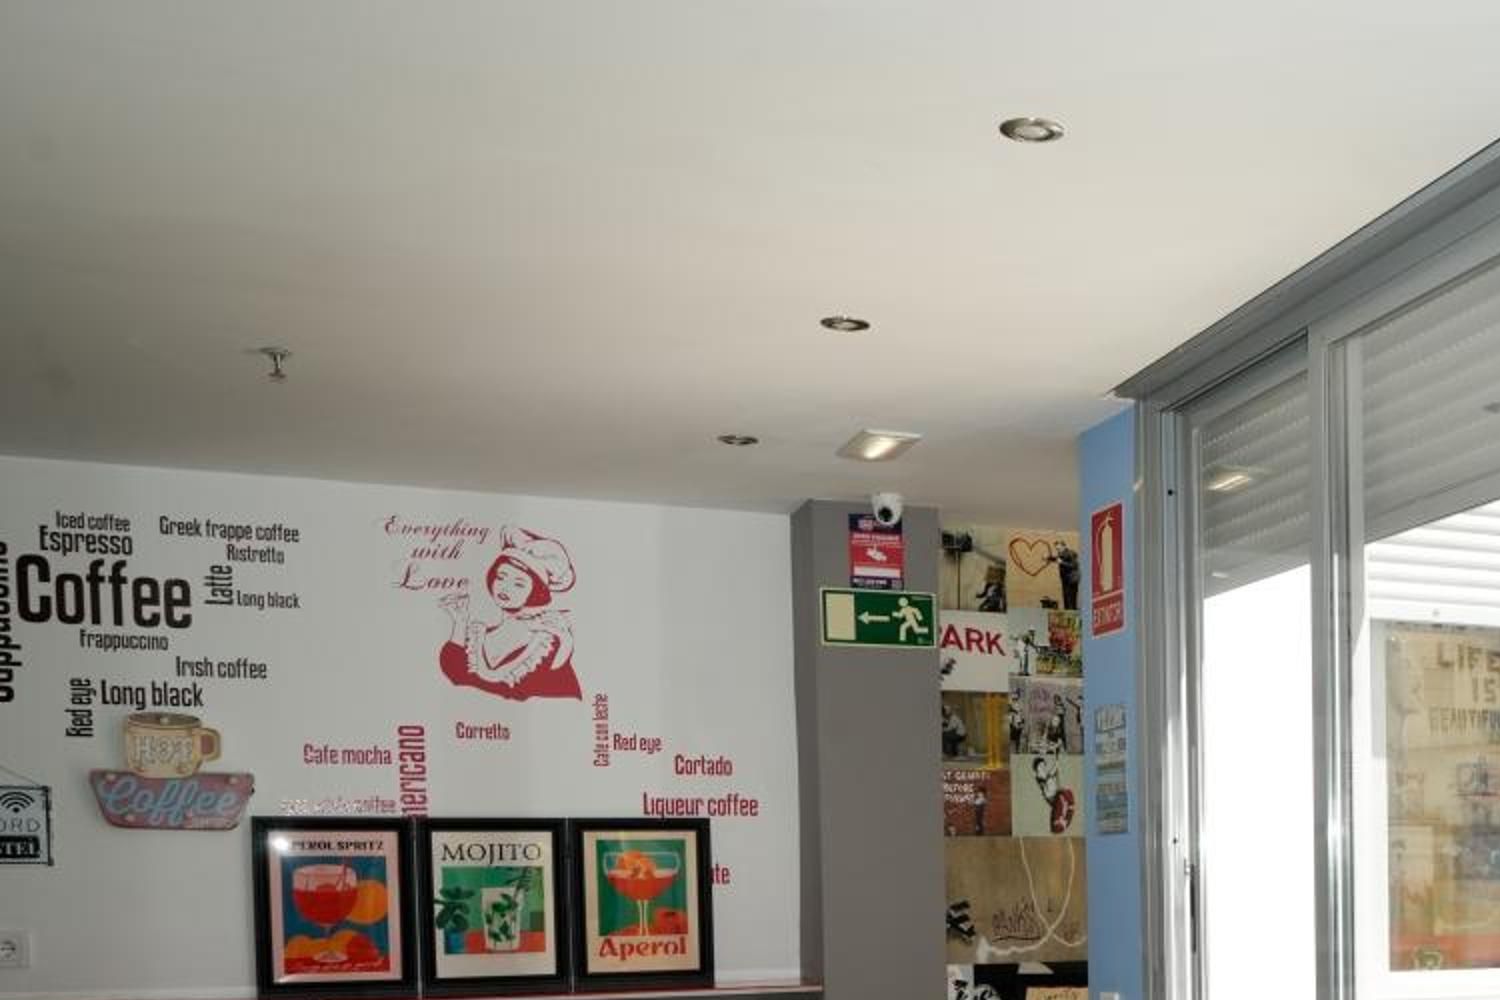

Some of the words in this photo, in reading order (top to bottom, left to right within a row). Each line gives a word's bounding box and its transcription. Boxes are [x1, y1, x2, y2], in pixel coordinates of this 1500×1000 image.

[55, 511, 84, 529] Iced
[88, 513, 131, 532] coffee
[159, 515, 201, 537] Greek
[205, 518, 253, 542] frappe
[256, 523, 300, 543] coffee
[384, 514, 491, 545] Everything
[38, 525, 133, 556] Espresso
[410, 540, 464, 560] with
[227, 543, 285, 564] Ristretto
[203, 565, 233, 605] Latte
[395, 561, 470, 591] Love
[16, 554, 192, 629] Coffee
[236, 590, 265, 611] Long
[267, 592, 301, 609] black
[79, 628, 169, 652] Frappuccino
[939, 623, 1006, 656] ARK
[176, 656, 213, 677] Irish
[217, 658, 268, 679] coffee
[69, 678, 97, 705] eye
[100, 679, 146, 710] Long
[151, 681, 204, 707] black
[65, 709, 94, 738] Red
[456, 721, 510, 740] Corretto
[303, 743, 338, 765] Cafe
[341, 745, 393, 765] mocha
[613, 732, 637, 751] Red
[640, 737, 662, 754] eye
[674, 754, 733, 776] Cortado
[104, 776, 238, 826] Coffee
[643, 792, 705, 819] Liqueur
[707, 793, 759, 817] coffee
[292, 840, 334, 850] PEROL
[441, 843, 542, 865] MOJITO
[599, 937, 687, 961] Aperol
